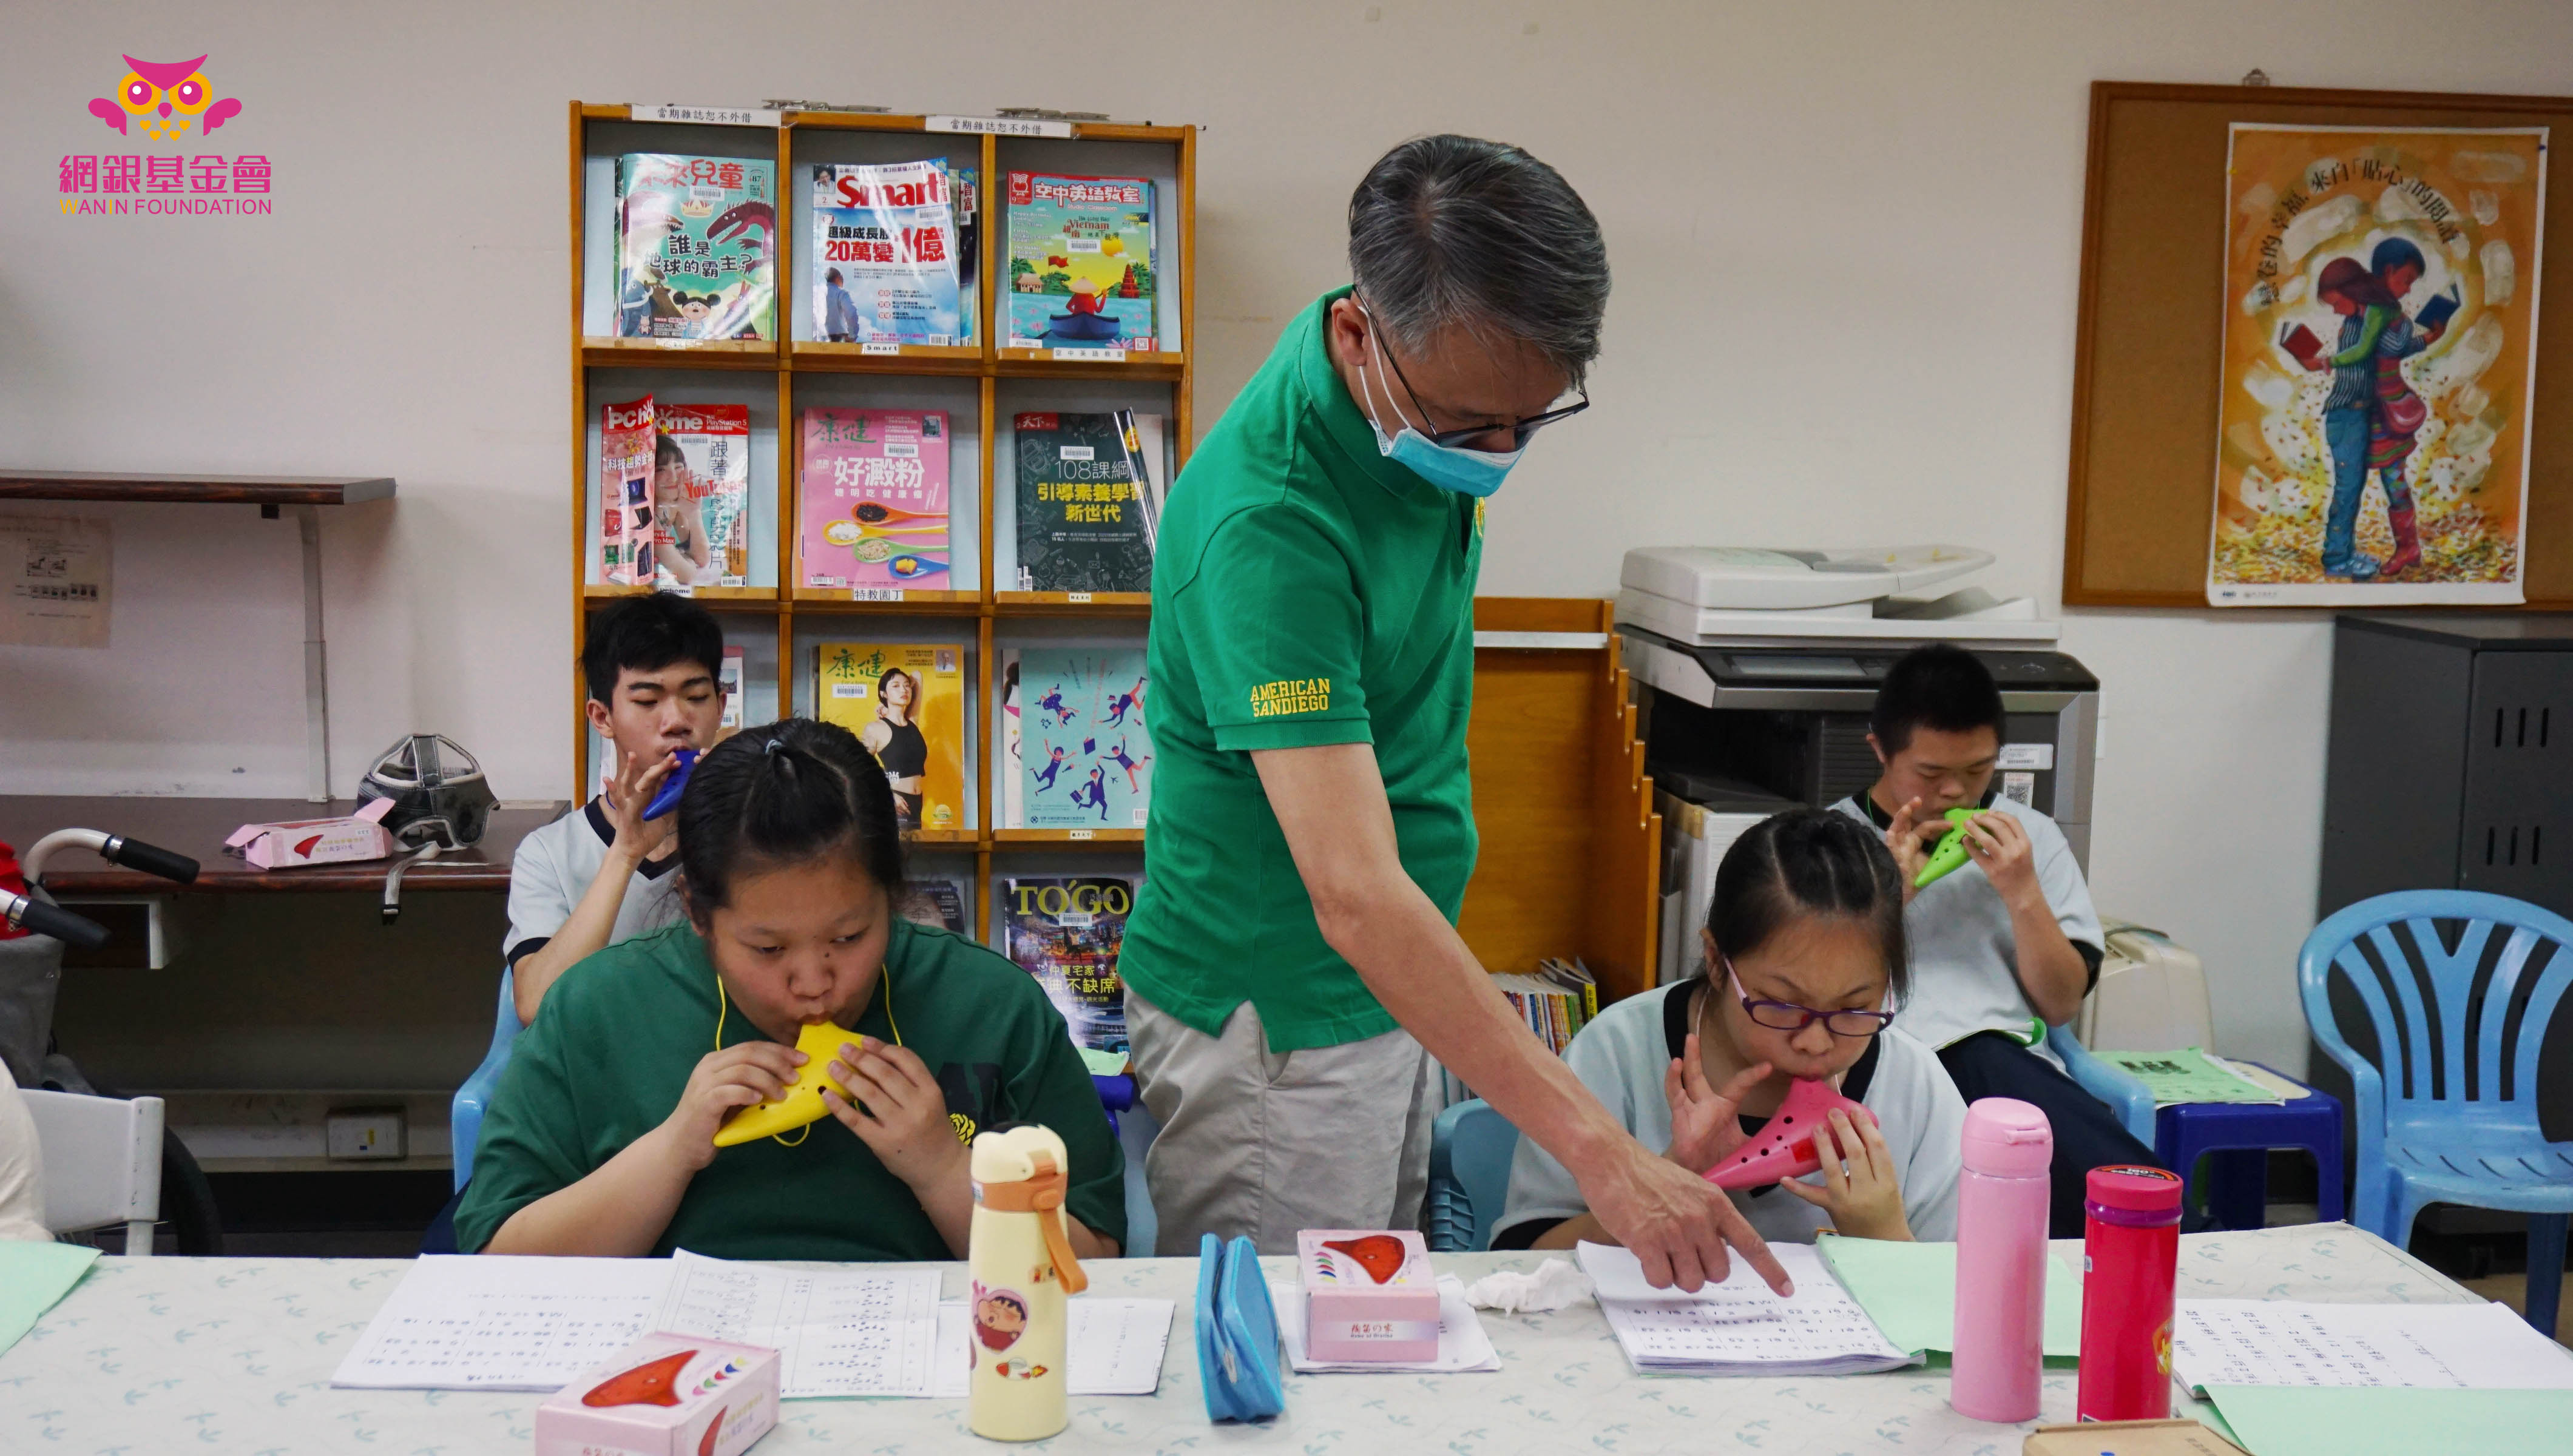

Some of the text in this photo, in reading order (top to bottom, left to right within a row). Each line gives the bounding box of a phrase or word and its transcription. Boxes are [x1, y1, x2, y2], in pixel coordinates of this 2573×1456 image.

[657, 107, 752, 123] 當期雜誌恕不外借
[950, 118, 1043, 135] 當期雜誌恕不外借
[836, 172, 939, 209] Smart
[1034, 181, 1141, 208] 空中英語教室
[1068, 218, 1110, 230] Vietnam
[668, 234, 711, 257] 誰是
[1055, 349, 1123, 359] 空中英語教室
[834, 456, 925, 488] 好澱粉
[1055, 460, 1130, 480] 108課綱
[1065, 504, 1122, 522] 新世代
[854, 589, 903, 601] 特教園丁
[1249, 678, 1331, 703] AMERICAN
[1253, 694, 1329, 718] SANDIEGO
[1049, 965, 1095, 976] 仲夏宅家
